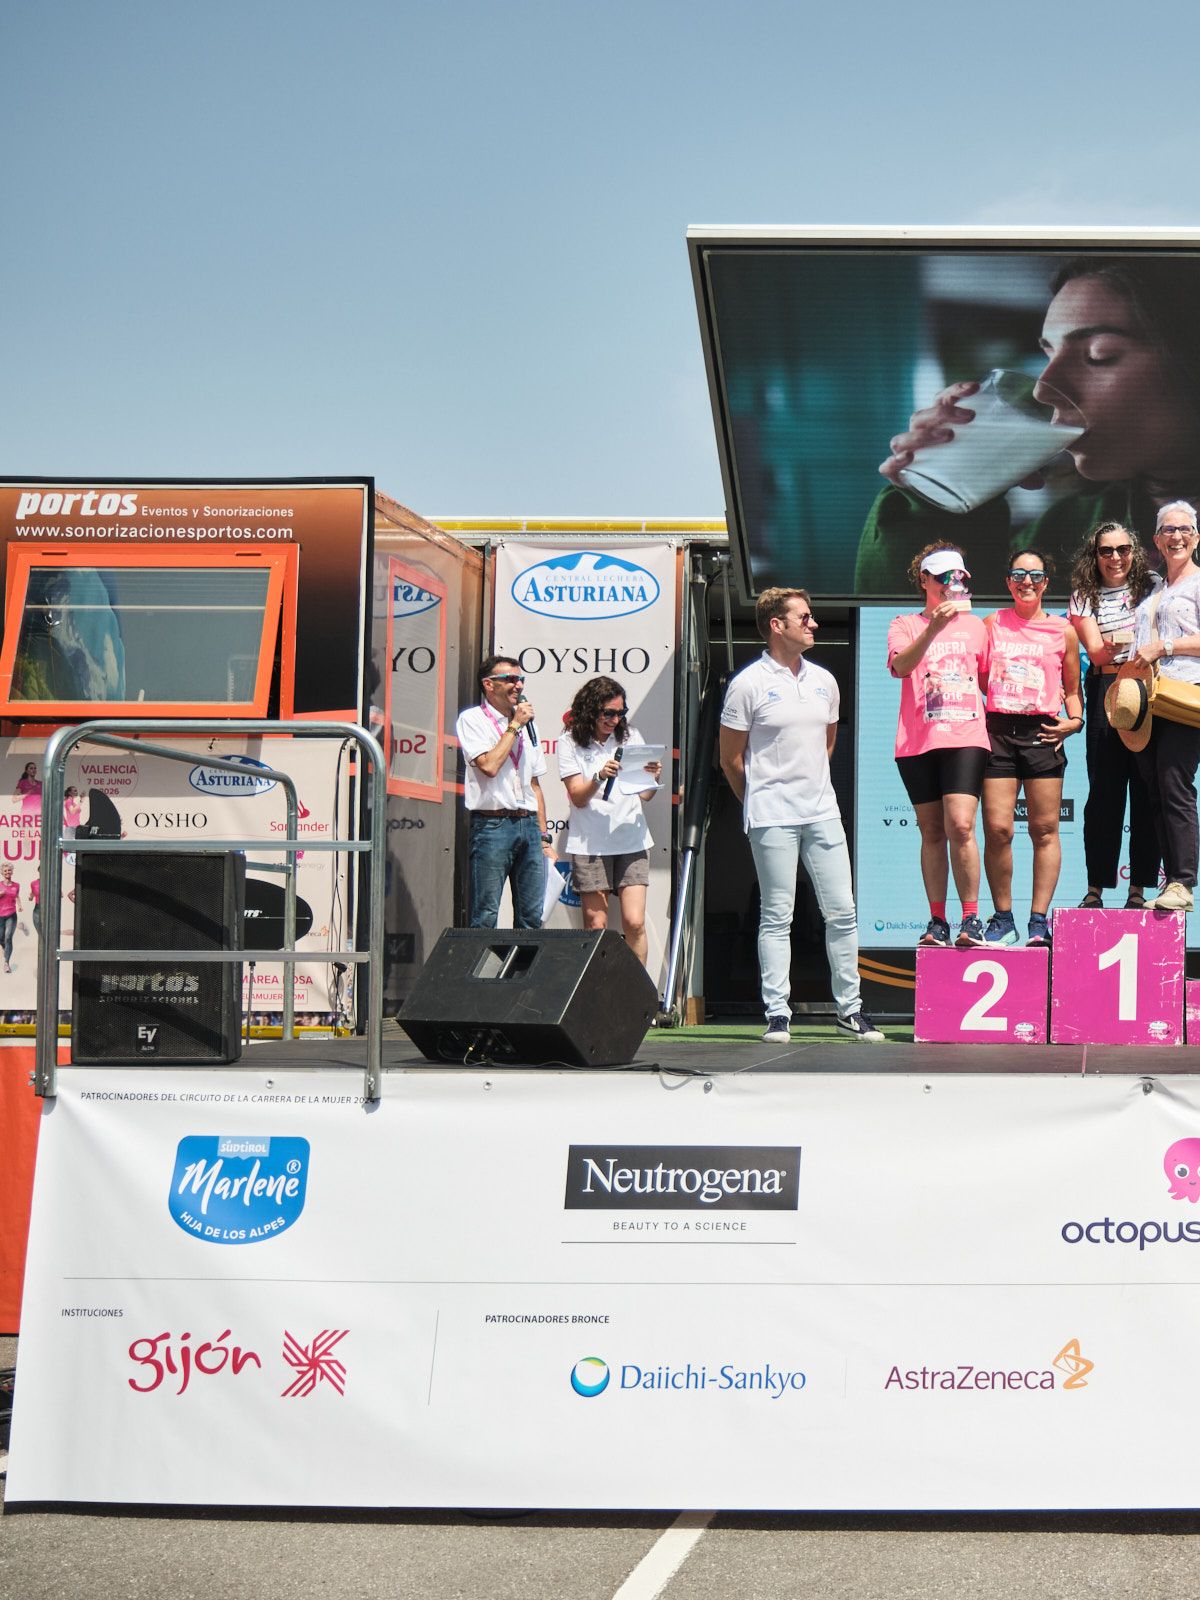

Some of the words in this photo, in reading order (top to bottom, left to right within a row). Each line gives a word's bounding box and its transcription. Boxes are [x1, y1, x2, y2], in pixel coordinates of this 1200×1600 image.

[16, 490, 138, 520] portos
[141, 505, 188, 517] Eventos
[192, 508, 199, 519] y
[203, 505, 294, 518] Sonorizaciones
[15, 524, 294, 541] www.sonorizacionesportos.com
[523, 577, 648, 602] ASTURIANA
[518, 647, 650, 673] OYSHO
[81, 765, 137, 774] VALENCIA
[196, 770, 272, 786] ASTURIANA
[134, 812, 208, 829] OYSHO
[270, 821, 330, 832] Saander
[12, 830, 25, 838] DE
[29, 830, 41, 838] LA
[280, 975, 314, 984] OSA
[1099, 933, 1139, 1021] 1
[960, 960, 1008, 1031] 2
[80, 1092, 159, 1101] PATROCINADORES
[161, 1093, 176, 1101] DEL
[180, 1093, 222, 1102] CIRCUITO
[223, 1094, 235, 1102] DE
[251, 1095, 292, 1103] CARRERA
[322, 1096, 351, 1104] MUJER
[178, 1158, 299, 1215] Marlene
[582, 1158, 783, 1203] Neutrogena
[180, 1211, 202, 1232] HIJA
[204, 1226, 221, 1238] DE
[223, 1229, 246, 1239] LOS
[249, 1216, 286, 1238] ALPES
[613, 1221, 659, 1231] BEAUTY
[663, 1222, 680, 1231] TO
[683, 1222, 691, 1231] A
[695, 1222, 747, 1232] SCIENCE
[61, 1308, 124, 1317] INSTITUCIONES
[485, 1315, 569, 1324] PATROCINADORES
[571, 1315, 610, 1324] BRONCE
[128, 1329, 262, 1396] gijón
[620, 1364, 807, 1399] Daiichi-Sankyo
[884, 1366, 1055, 1390] AstraZeneca
